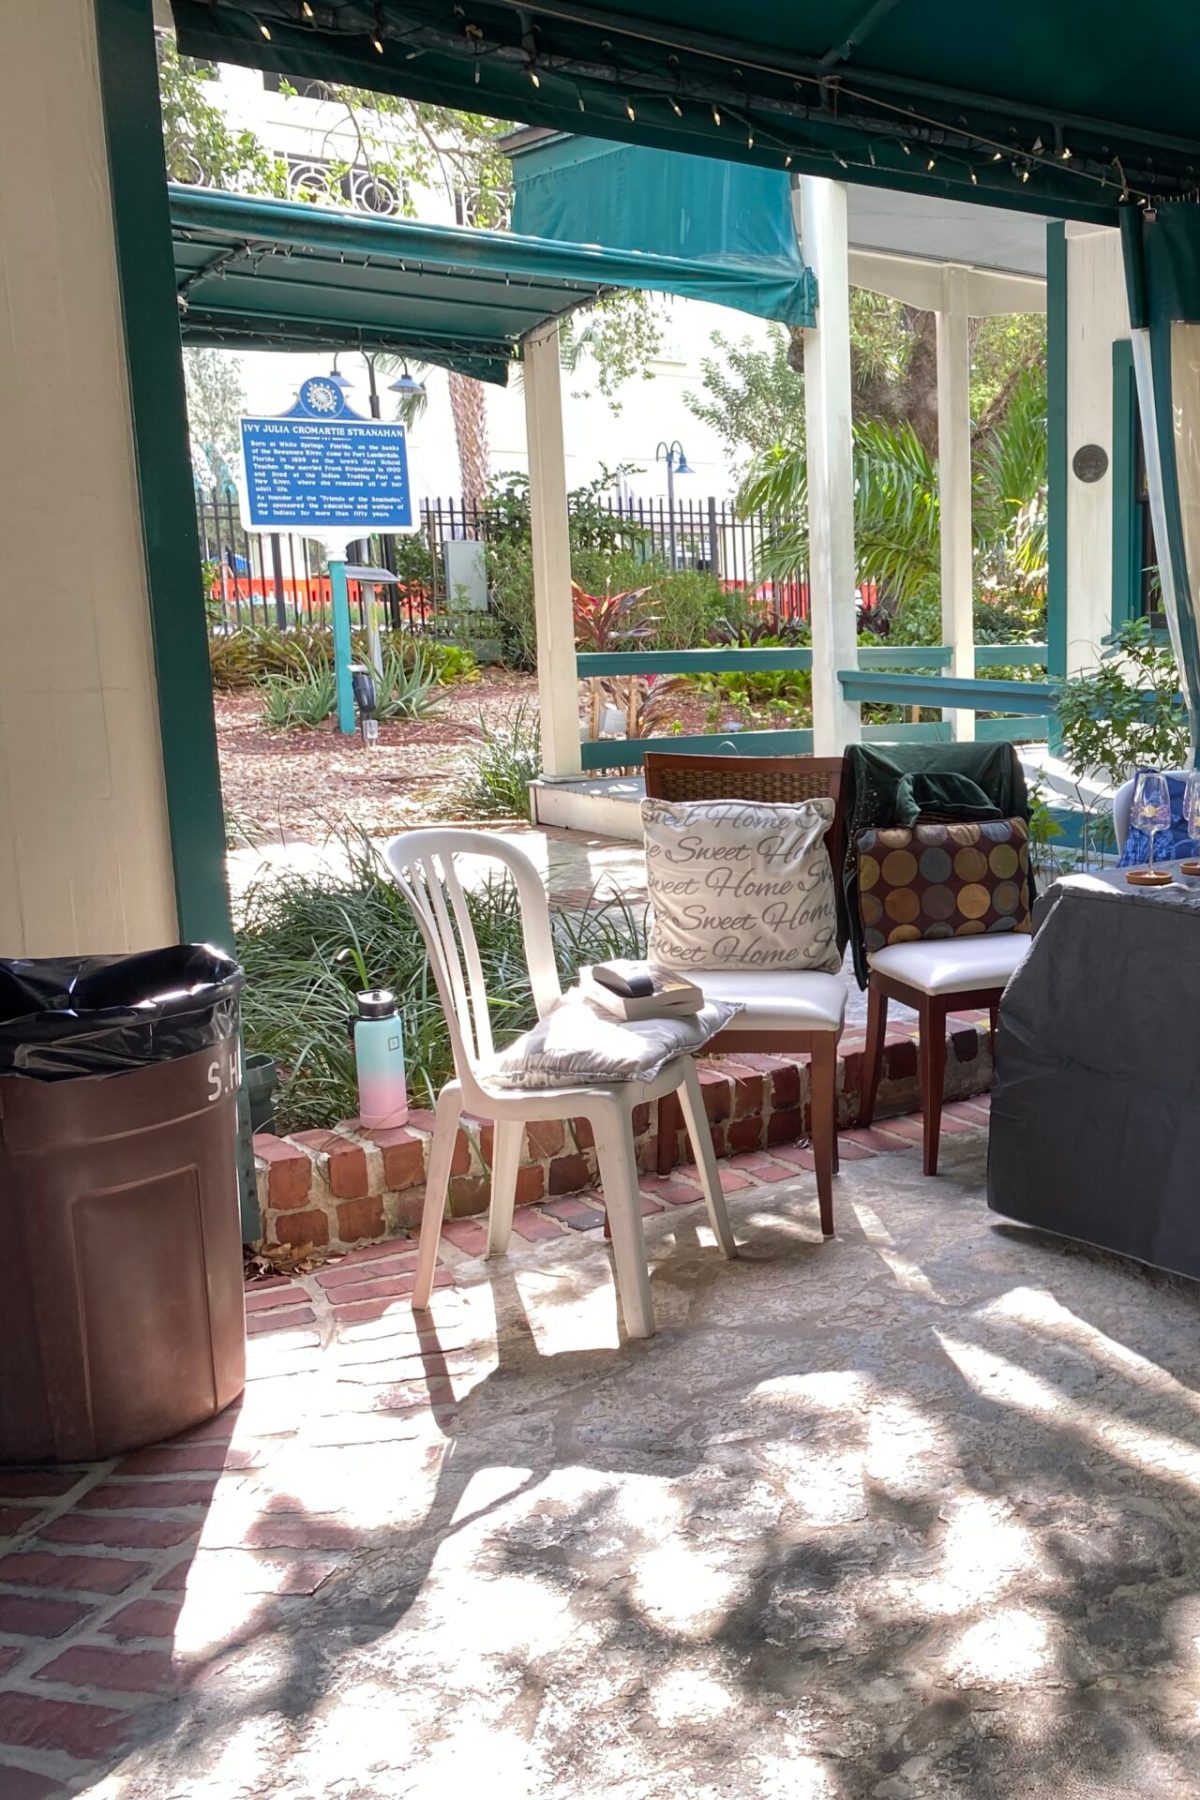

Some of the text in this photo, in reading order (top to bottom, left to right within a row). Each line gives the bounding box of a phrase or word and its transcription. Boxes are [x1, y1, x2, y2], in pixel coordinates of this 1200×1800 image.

[244, 424, 402, 438] IVY JULIA CROMARTIE STRANAHAN
[665, 836, 752, 864] Sweet
[650, 876, 702, 896] weet
[705, 866, 794, 898] Home
[672, 894, 834, 933] Sweet Hom
[712, 935, 800, 964] Home
